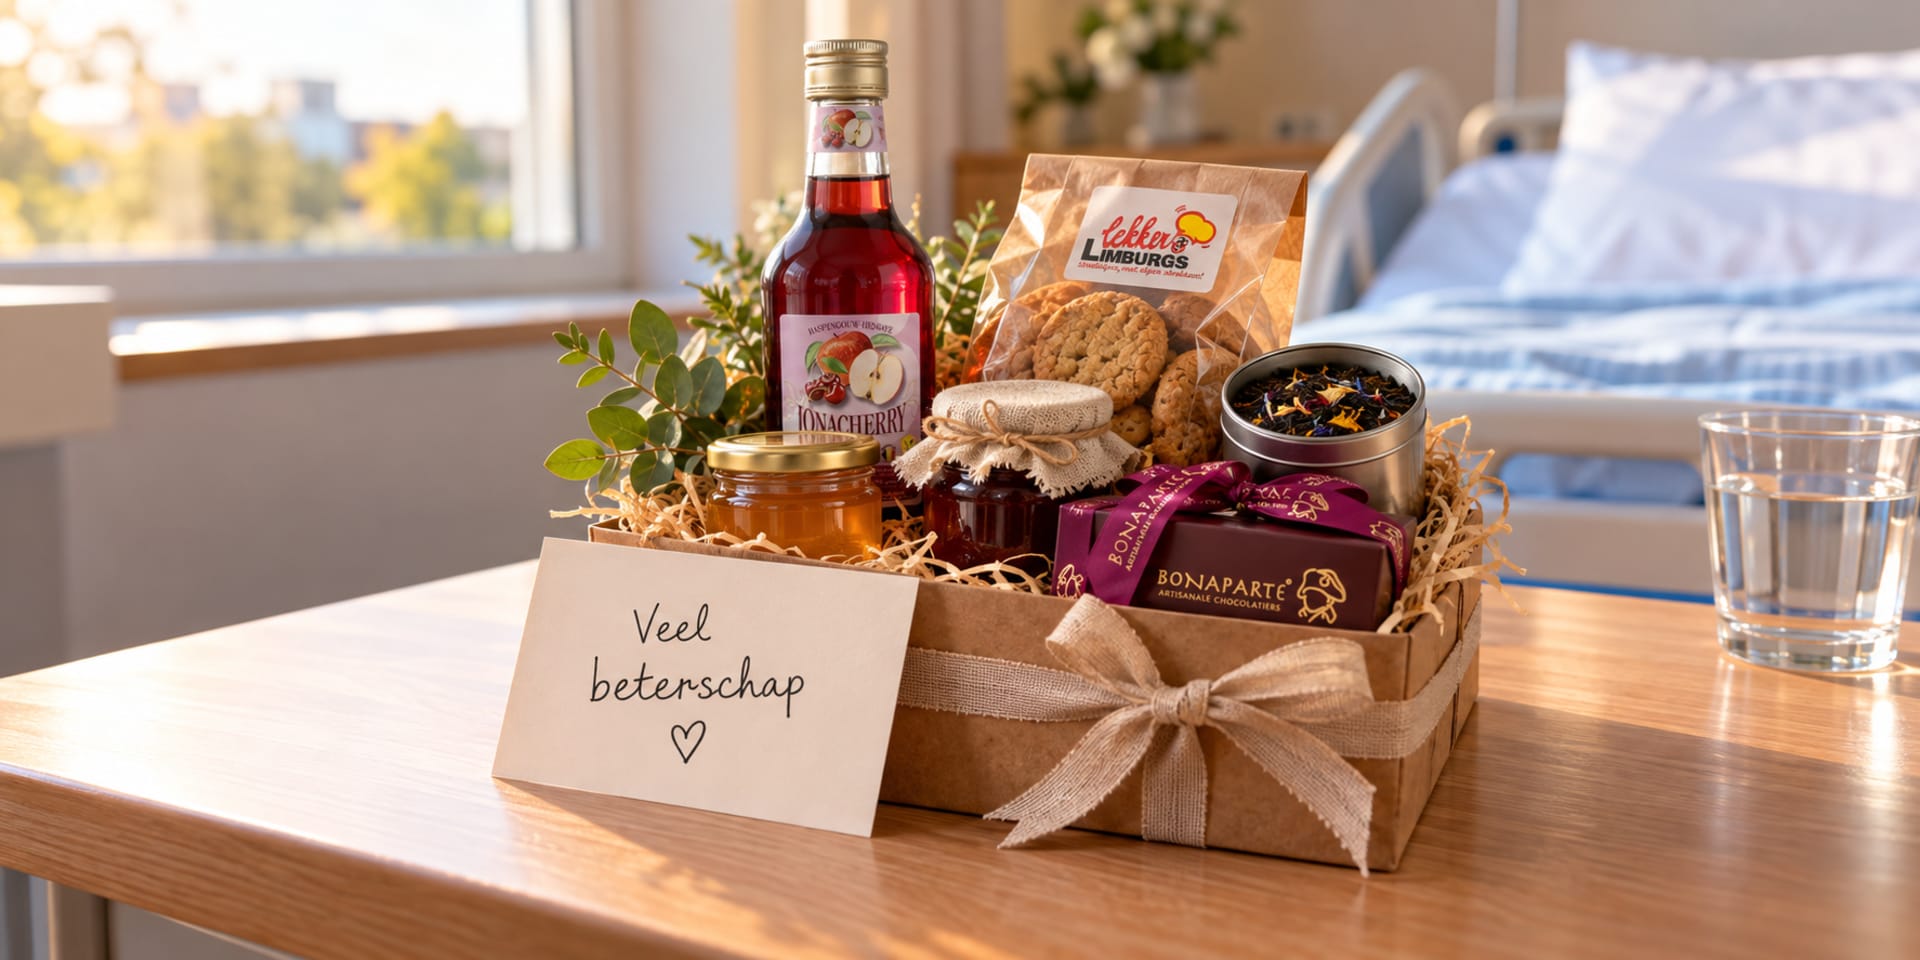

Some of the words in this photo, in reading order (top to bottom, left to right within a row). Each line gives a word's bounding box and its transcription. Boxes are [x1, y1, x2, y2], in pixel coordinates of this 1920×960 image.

[1102, 215, 1174, 250] lekker
[1080, 238, 1189, 269] LIMBURGS
[1158, 589, 1212, 603] ARTISANALE
[1213, 596, 1281, 612] CHOCOLATIERS
[633, 602, 712, 644] Veel
[589, 655, 805, 719] beterschap
